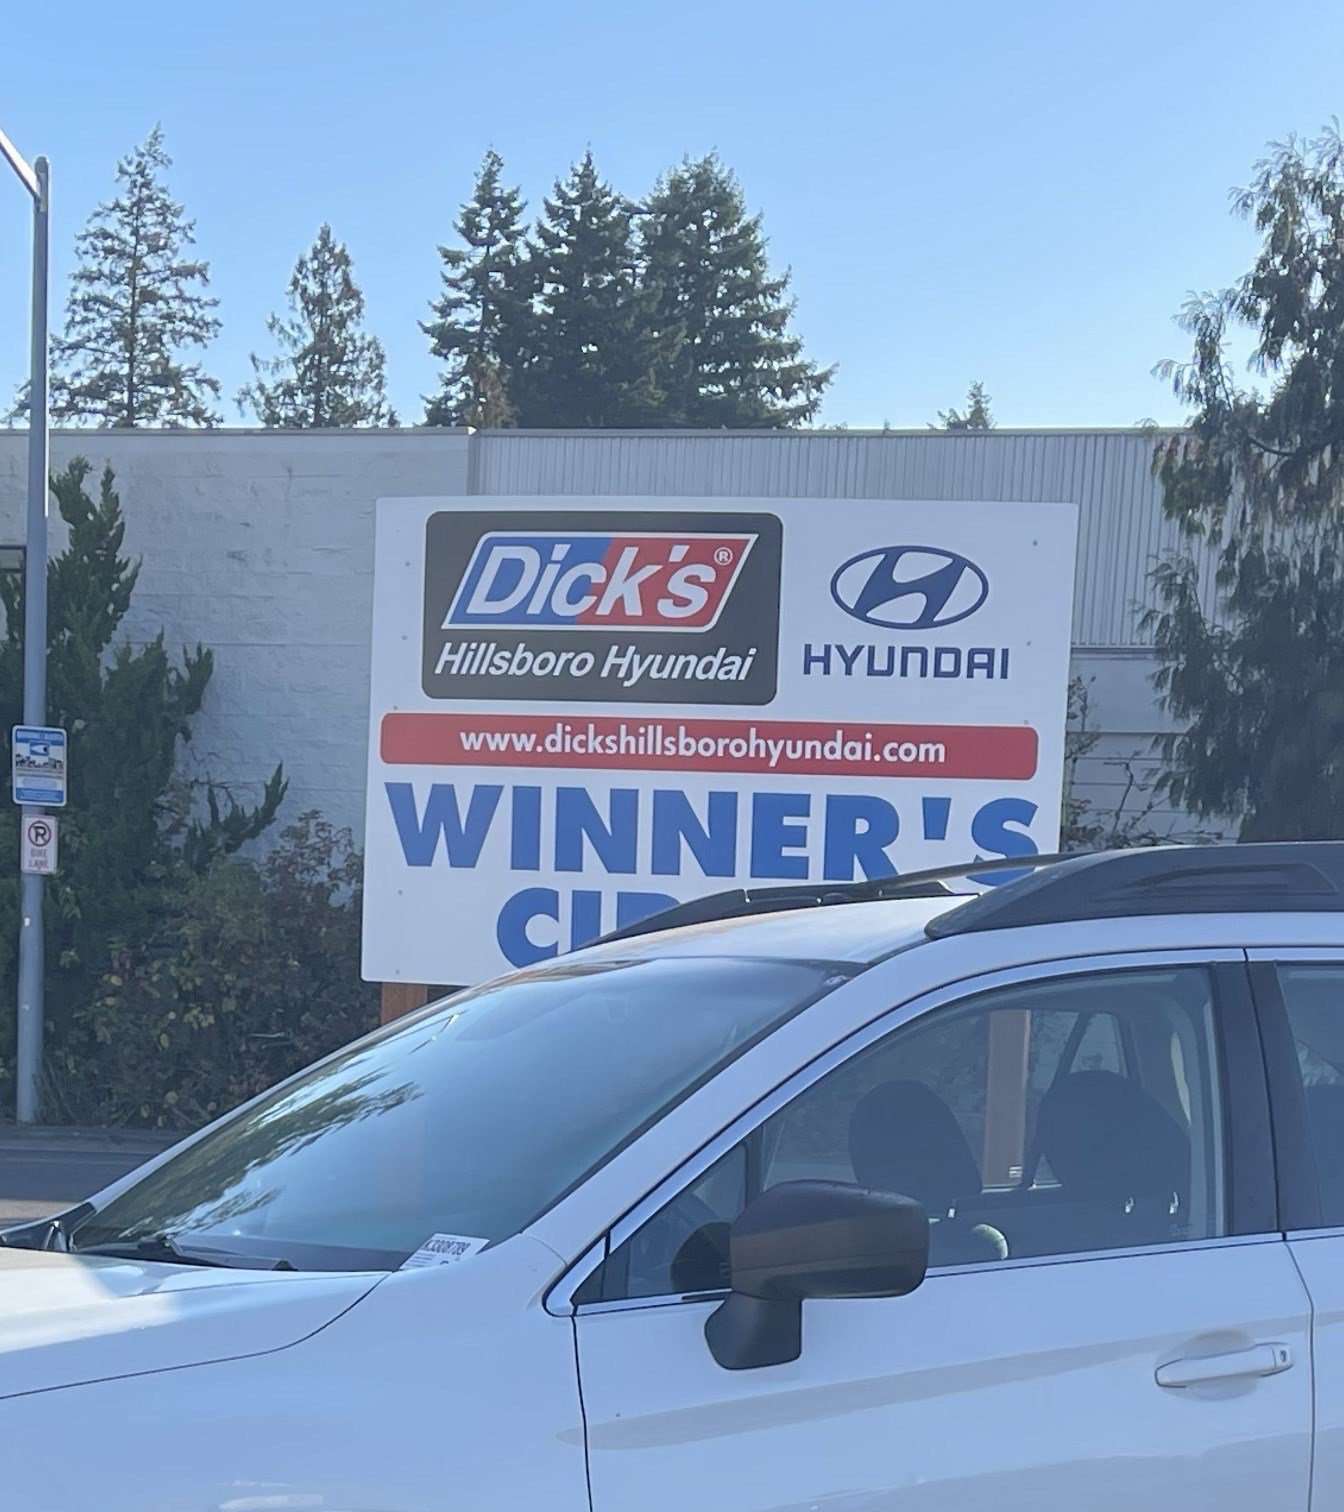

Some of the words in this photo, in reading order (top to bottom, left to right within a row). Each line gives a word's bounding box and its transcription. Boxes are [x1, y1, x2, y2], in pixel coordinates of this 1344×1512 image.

[434, 642, 595, 677] Hillsboro
[600, 645, 757, 687] Hyundai
[803, 643, 1010, 680] HYUNDAI
[459, 721, 946, 767] www.dickshillsborohyundai.com
[384, 781, 1040, 887] WINNER'S
